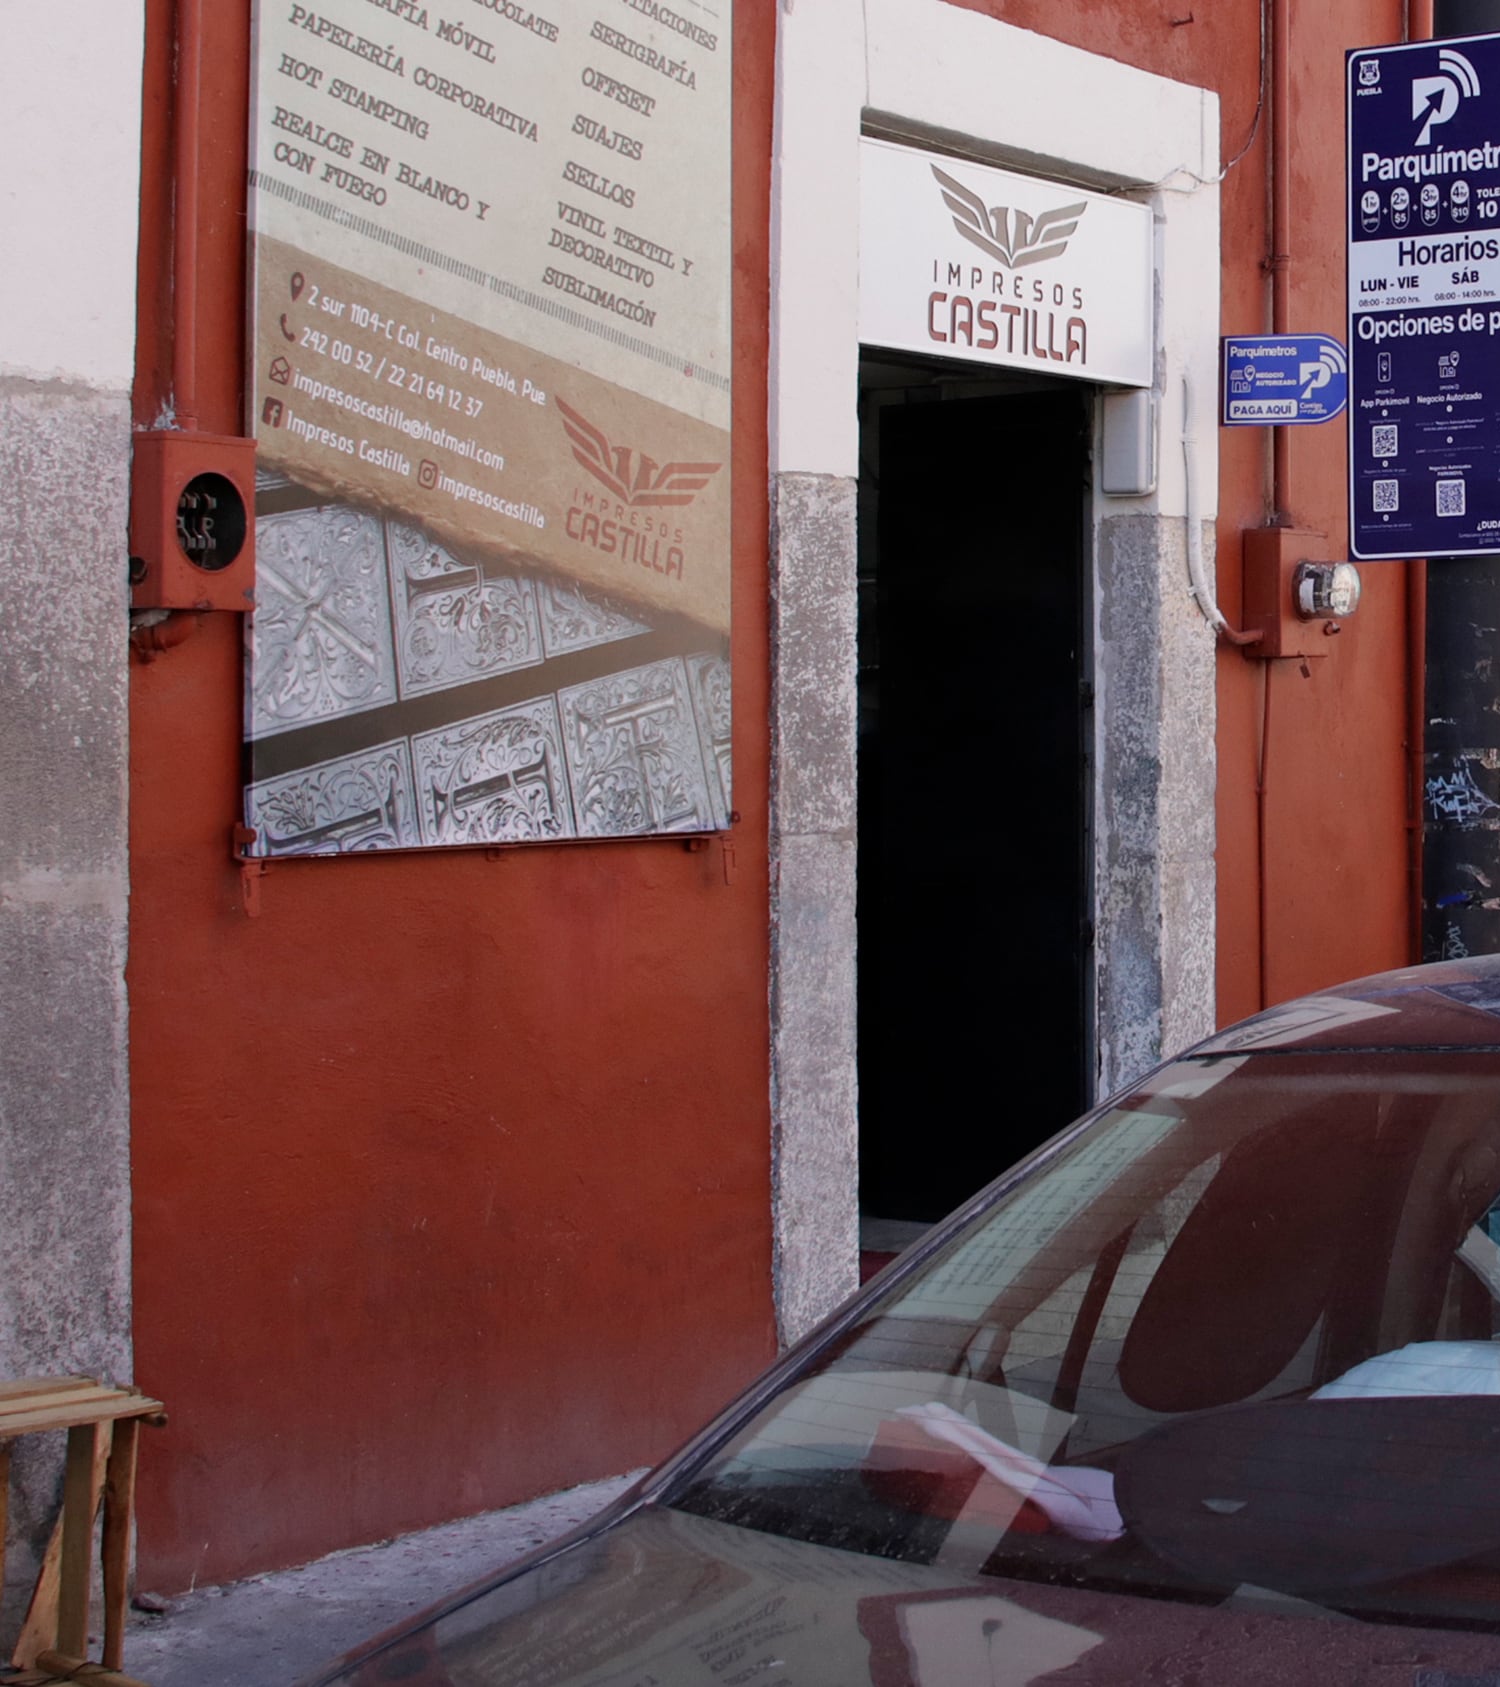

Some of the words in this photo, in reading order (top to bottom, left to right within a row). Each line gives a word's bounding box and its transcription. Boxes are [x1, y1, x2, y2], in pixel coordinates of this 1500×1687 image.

[435, 19, 497, 64] MÓVIL
[589, 20, 697, 90] SERIGRAFÍA
[277, 53, 323, 89] HOT
[327, 78, 430, 140] STAMPING
[288, 3, 406, 78] PAPELERÍA
[412, 66, 539, 142] CORPORATIVA
[581, 66, 656, 117] OFFSET
[271, 106, 354, 159] REALCE
[359, 148, 390, 176] EN
[395, 161, 471, 211] BLANCO
[476, 200, 491, 221] Y
[570, 114, 645, 161] SUAJES
[273, 142, 317, 177] CON
[319, 162, 388, 207] FUEGO
[561, 160, 637, 209] SELLOS
[1394, 212, 1407, 224] $5
[1424, 209, 1437, 221] $5
[1452, 207, 1469, 219] $10
[1476, 200, 1498, 219] 10
[547, 227, 656, 290] DECORATIVO
[556, 200, 607, 239] VINIL
[613, 226, 676, 270] TEXTIL
[681, 258, 695, 278] Y
[1398, 235, 1500, 267] Horarios
[541, 265, 658, 328] SUBLIMACIÓN
[932, 258, 1084, 311] IMPRESOS
[1360, 278, 1388, 293] LUN
[1397, 275, 1420, 289] VIE
[1451, 267, 1480, 285] SÁB
[307, 285, 318, 306] 2
[321, 295, 346, 317] sur
[350, 303, 396, 340] 1104-C
[397, 323, 421, 350] Col.
[425, 337, 469, 371] Centro
[471, 357, 518, 396] Puebla,
[521, 377, 548, 406] Pue
[927, 290, 1088, 366] CASTILLA
[1357, 313, 1455, 344] Opciones
[1458, 307, 1485, 332] de
[299, 326, 328, 355] 242
[330, 338, 351, 366] 00
[355, 350, 373, 374] 52
[387, 364, 405, 388] 22
[407, 372, 425, 395] 21
[448, 388, 461, 412] 12
[464, 395, 484, 419] 37
[1229, 344, 1298, 360] Parquímetros
[293, 367, 505, 472] impresoscastilla@hotmail.com
[1233, 404, 1264, 416] PAGA
[1265, 401, 1293, 416] AQUÍ
[1416, 394, 1446, 406] Negocio
[1446, 390, 1483, 402] Autorizado
[358, 439, 412, 477] Castilla
[437, 470, 546, 529] impresoscastilla
[573, 487, 684, 544] IMPRESOS
[565, 505, 685, 581] CASTILLA
